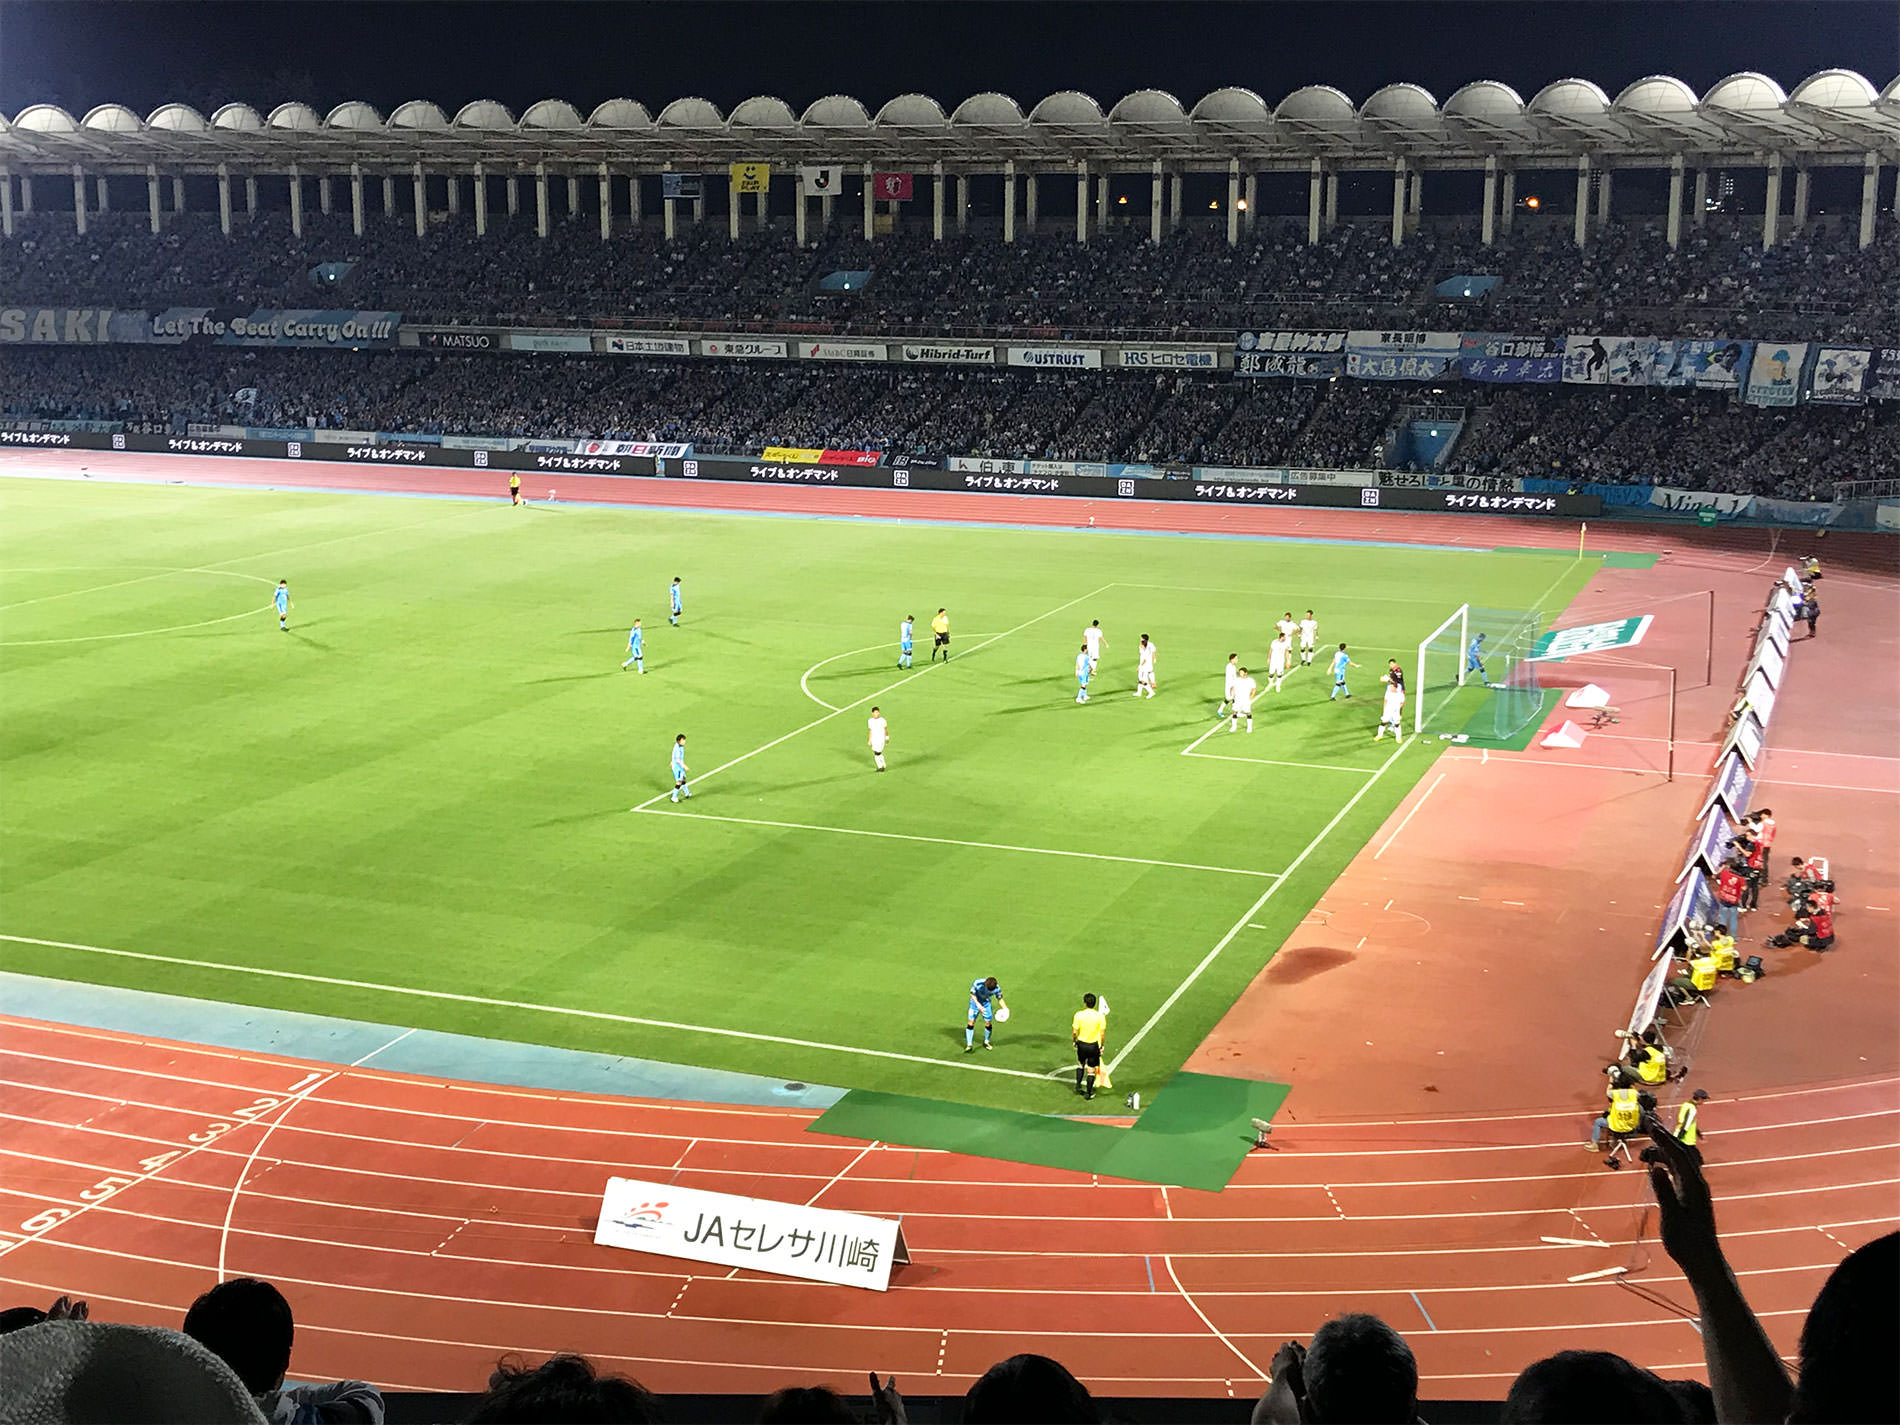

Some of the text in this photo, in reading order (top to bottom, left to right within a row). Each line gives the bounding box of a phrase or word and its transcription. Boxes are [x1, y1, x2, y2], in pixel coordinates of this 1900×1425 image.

[0, 309, 113, 342] SAKI
[153, 316, 188, 336] Let
[191, 317, 226, 335] The
[230, 317, 277, 337] Beat
[283, 318, 339, 342] Carry
[342, 320, 369, 339] On
[442, 336, 490, 348] MATSUO
[919, 348, 991, 360] Hibrid-Turf
[1124, 352, 1148, 365] HRS
[168, 439, 242, 452] ライブ&オンデマンド
[616, 444, 681, 456] 朝日新聞
[347, 447, 426, 461] ライブ&オンデマンド
[537, 456, 621, 470] ライブ&オンデマンド
[750, 466, 839, 480] ライブ&オンデマンド
[965, 475, 1059, 490] ライブ&オンデマンド
[1195, 485, 1296, 500] ライブ&オンデマンド
[1445, 494, 1556, 511] ライブ&オンデマンド
[288, 1073, 321, 1091] 1
[233, 1097, 279, 1117] 2
[188, 1123, 231, 1142] 3
[139, 1150, 181, 1170] 4
[80, 1176, 131, 1199] 5
[20, 1208, 70, 1231] 6
[683, 1213, 880, 1272] JAセレサ川崎
